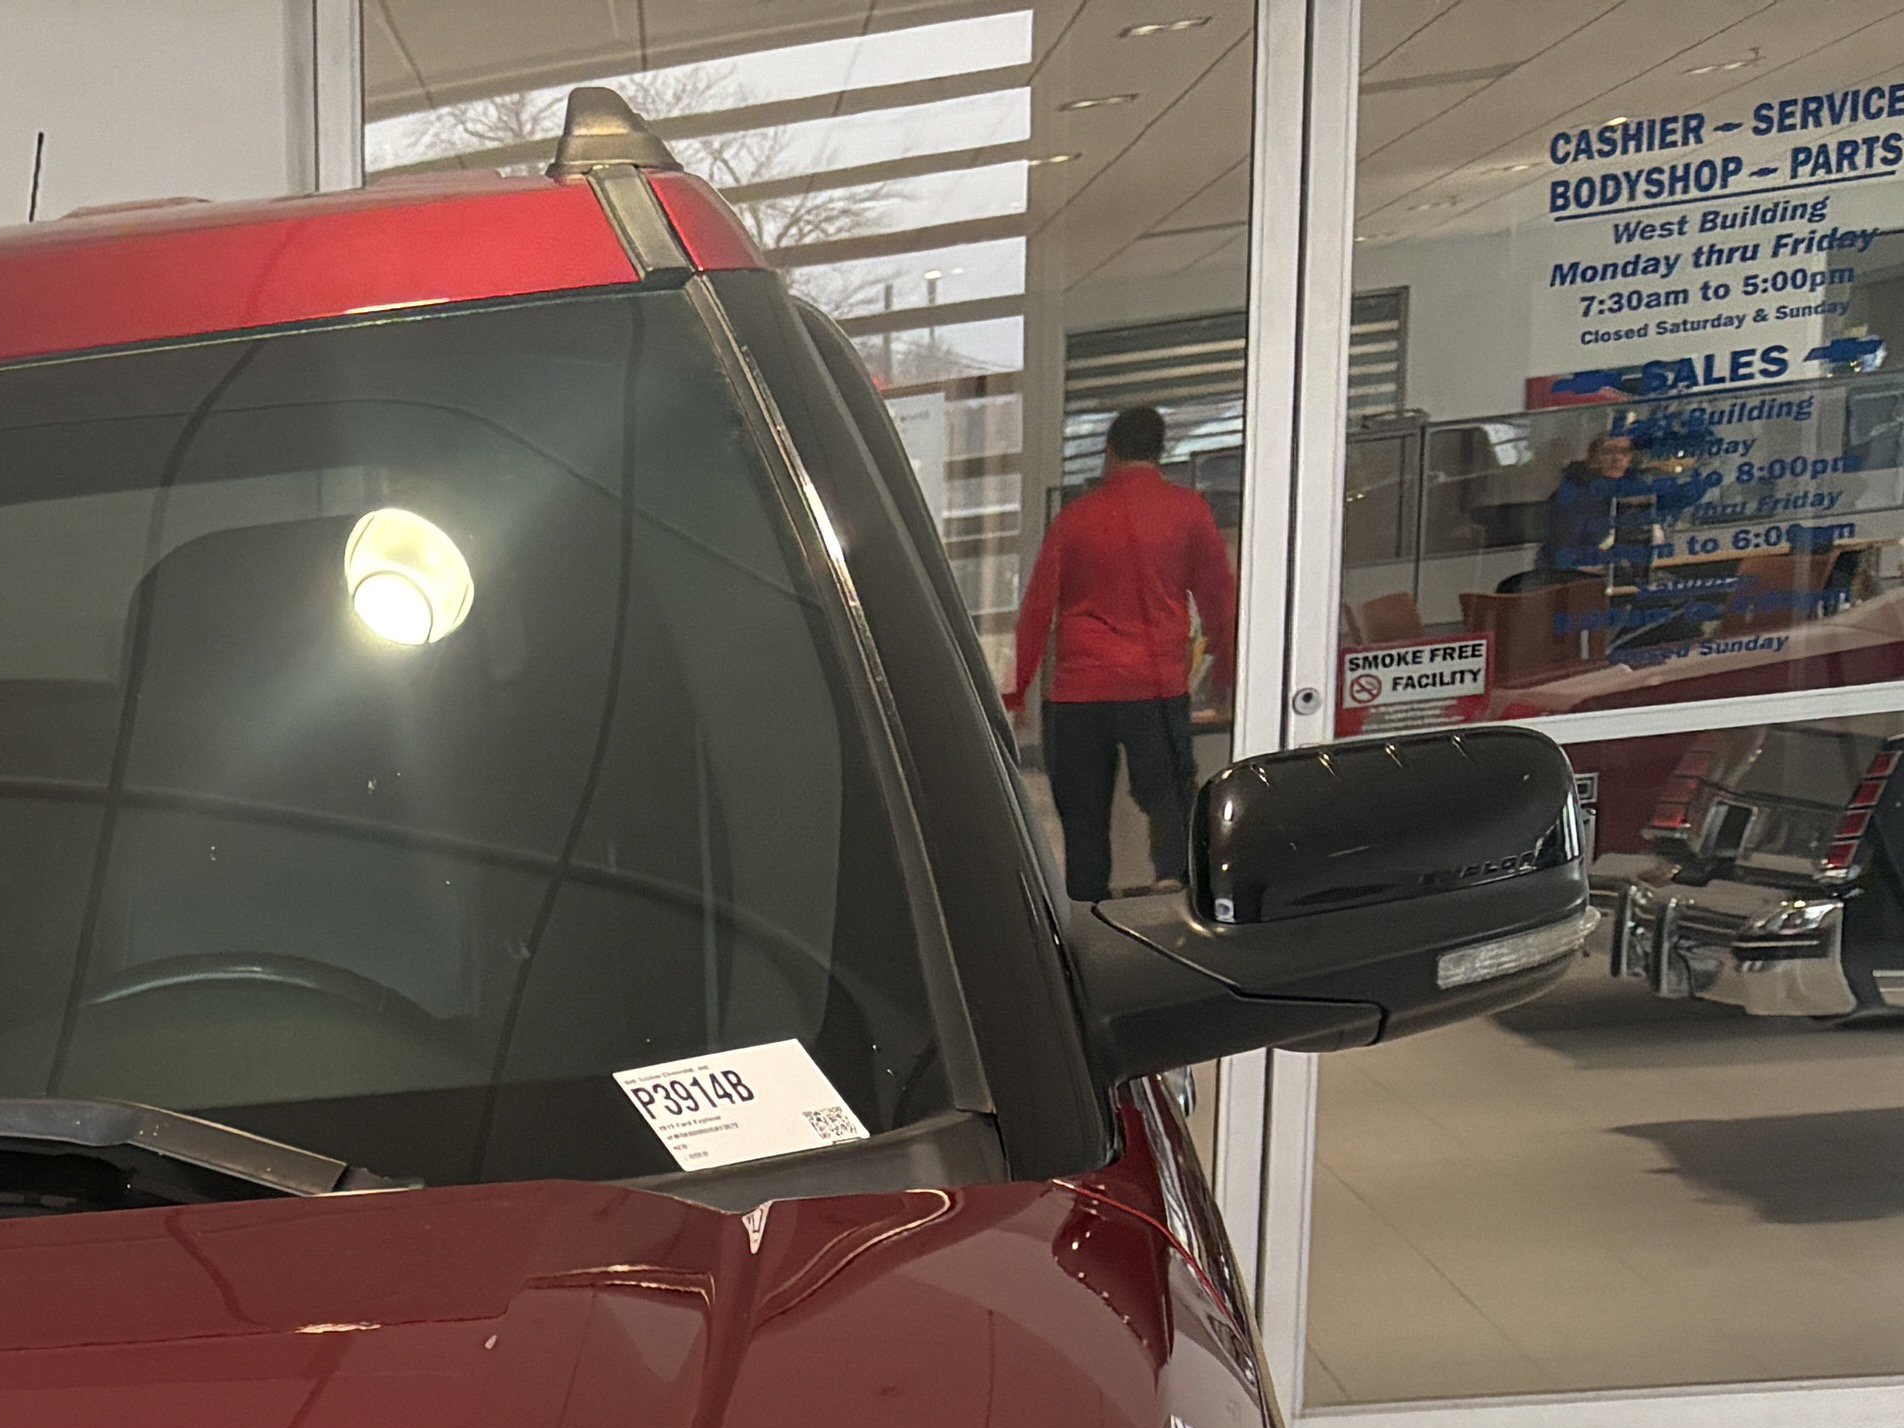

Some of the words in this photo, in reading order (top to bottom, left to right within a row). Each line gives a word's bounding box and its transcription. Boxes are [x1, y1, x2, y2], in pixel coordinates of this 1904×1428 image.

[1549, 112, 1706, 166] CASHIER
[1751, 83, 1904, 137] SERVICE
[1549, 155, 1743, 213] BODYSHOP
[1790, 132, 1904, 180] PARTS
[1612, 217, 1690, 245] West
[1698, 195, 1831, 234] Building
[1549, 252, 1682, 288] Monday
[1693, 242, 1760, 270] thru
[1770, 225, 1881, 259] Friday
[1580, 287, 1690, 318] 7:30am
[1699, 280, 1731, 302] to
[1742, 266, 1856, 297] 5:00pm
[1580, 323, 1649, 346] Closed
[1655, 312, 1747, 337] Saturday
[1752, 307, 1769, 323] &
[1774, 299, 1851, 322] Sunday
[1642, 344, 1790, 395] SALES
[1690, 396, 1815, 430] Building
[1755, 488, 1844, 514] Friday
[1686, 533, 1720, 555] to
[1731, 521, 1857, 551] 6:00m
[1348, 649, 1425, 672] SMOKE
[1429, 643, 1485, 663] FREE
[1699, 634, 1790, 659] Sunday
[1391, 667, 1482, 692] FACILITY
[630, 1069, 755, 1120] P3914B
